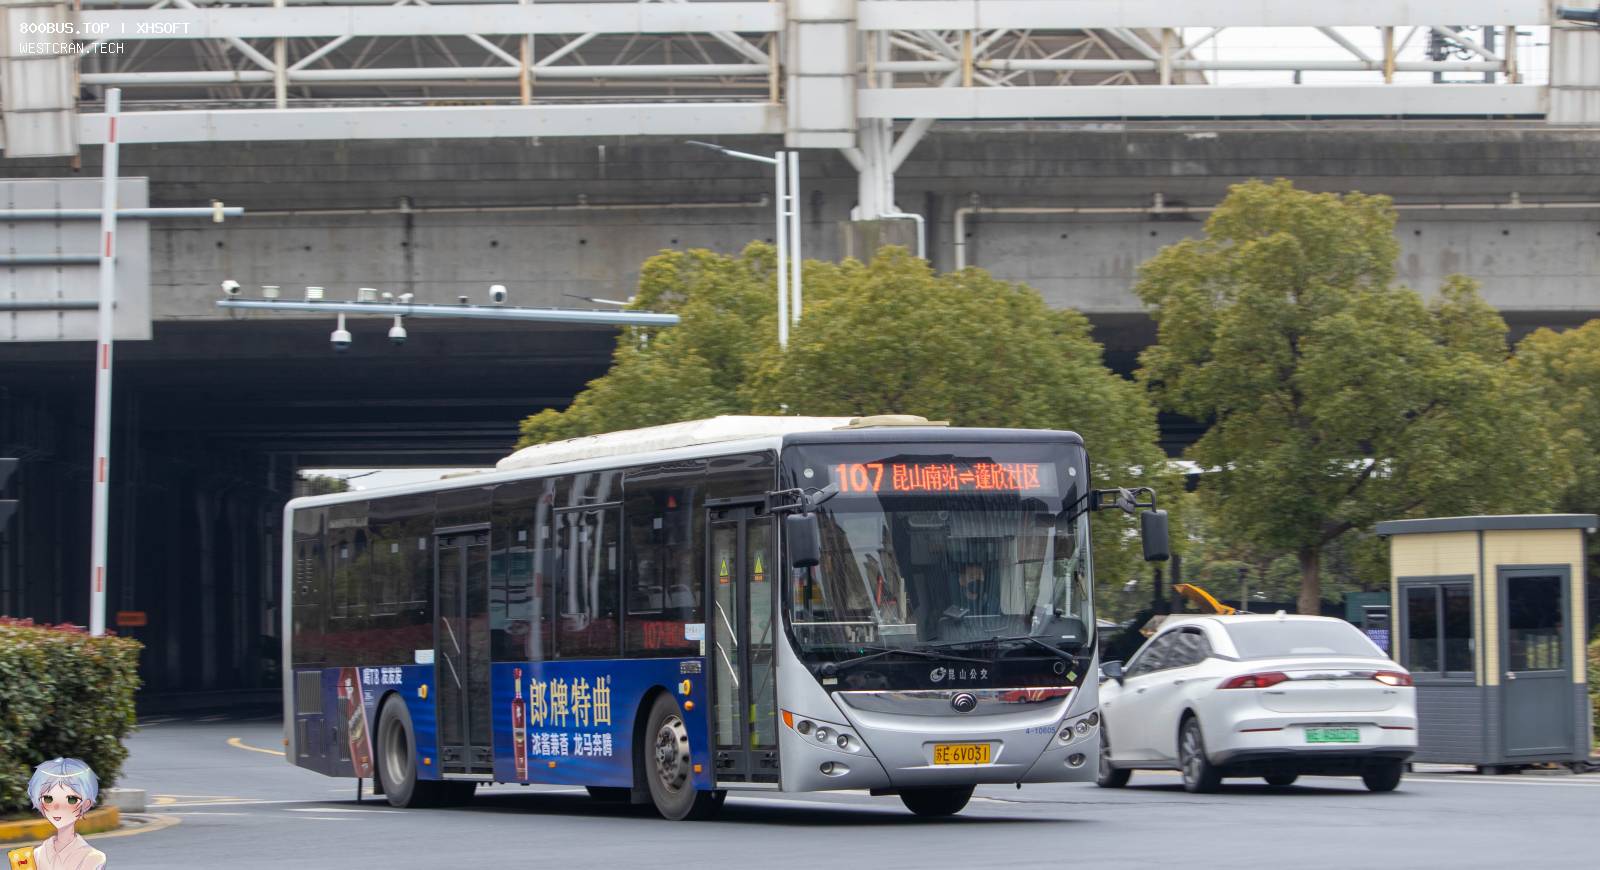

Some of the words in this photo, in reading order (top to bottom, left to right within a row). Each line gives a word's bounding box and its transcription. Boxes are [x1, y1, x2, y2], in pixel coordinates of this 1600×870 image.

[836, 463, 884, 492] 107
[892, 464, 959, 491] 昆山南站
[975, 463, 1041, 490] 蓬欣社区
[948, 668, 988, 680] 昆山公交
[530, 677, 612, 727] 郎牌特曲
[532, 732, 569, 757] 浓酱兼香
[573, 732, 613, 757] 龙马奔腾
